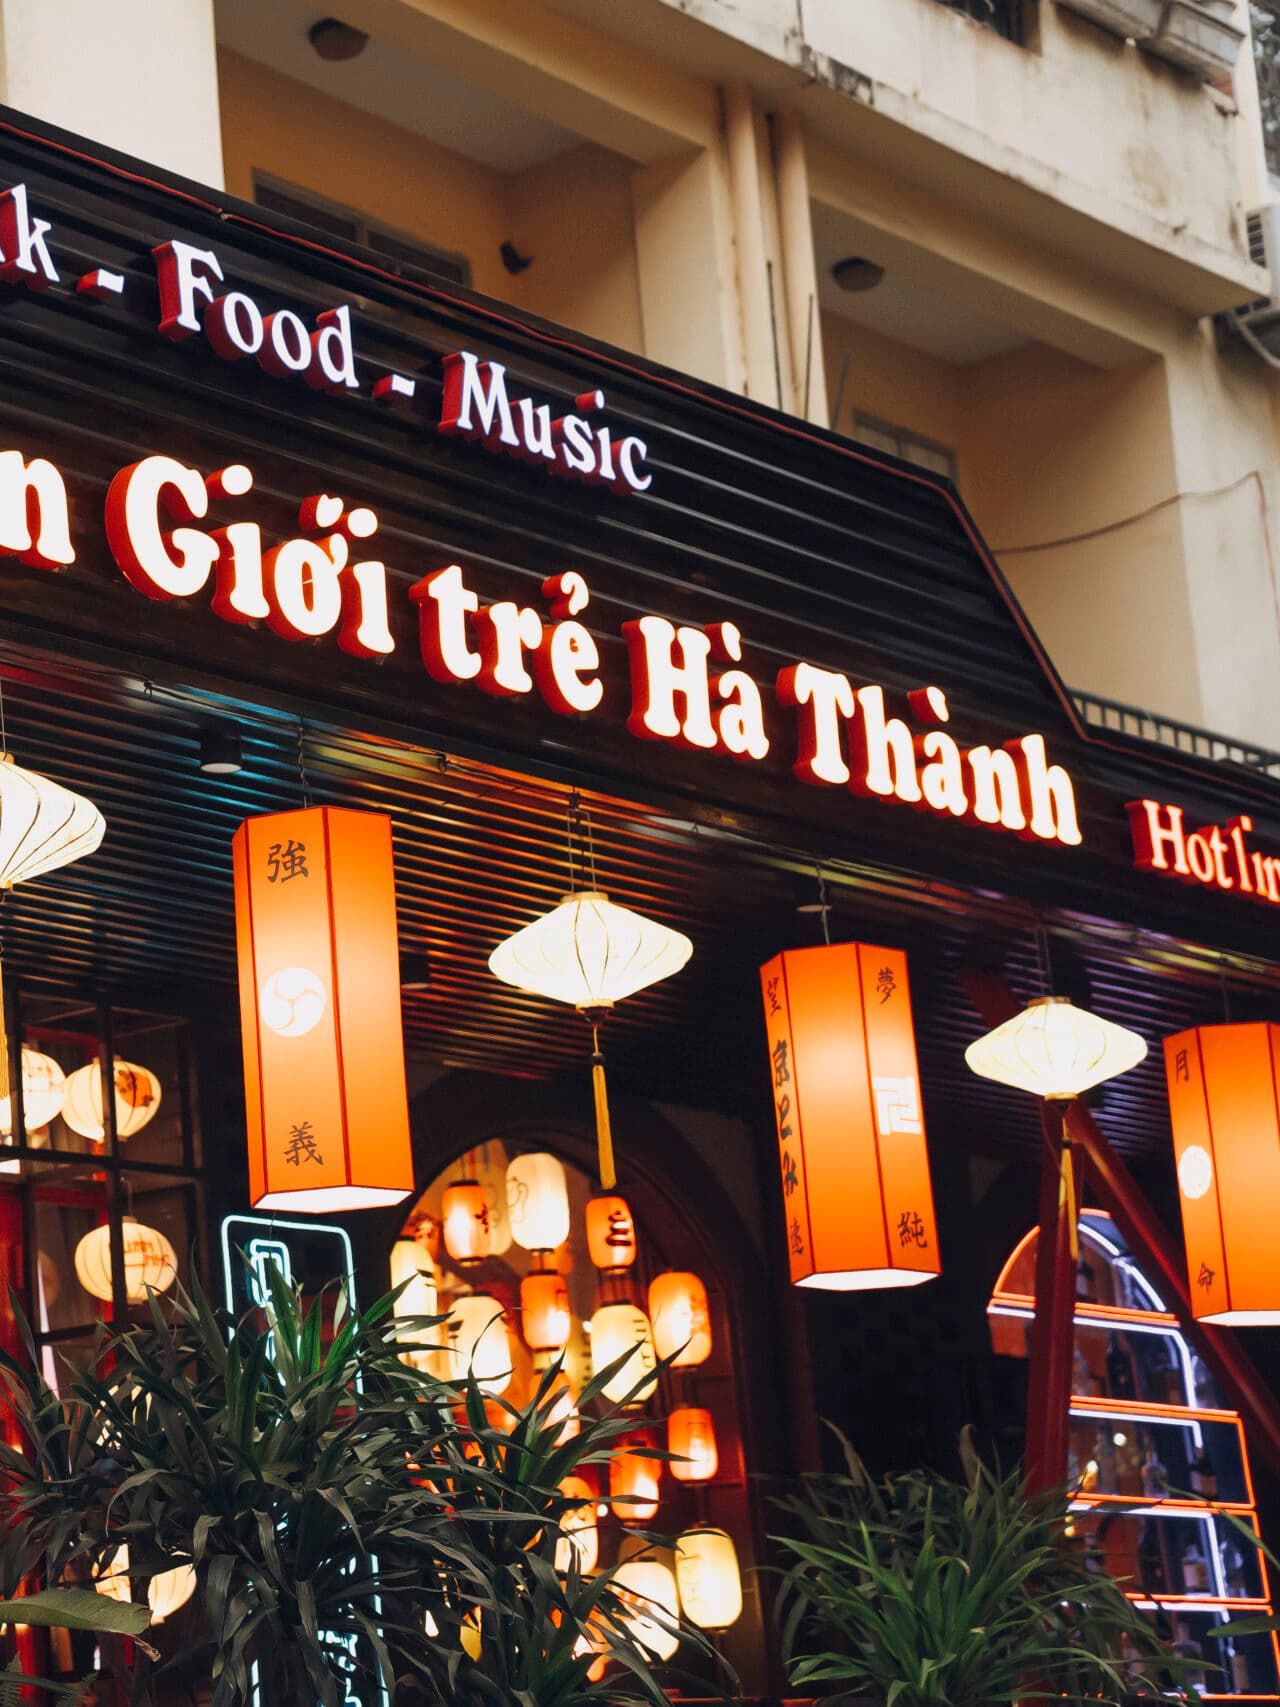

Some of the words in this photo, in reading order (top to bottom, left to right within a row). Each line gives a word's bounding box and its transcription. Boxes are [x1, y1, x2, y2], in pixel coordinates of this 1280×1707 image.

[169, 239, 360, 390] Food
[455, 350, 653, 493] Music
[124, 455, 397, 656] Giới
[427, 564, 605, 713] trẻ
[637, 614, 771, 761] Hà
[793, 661, 1083, 847] Thành
[265, 839, 310, 883] 強
[283, 1121, 325, 1167] 義
